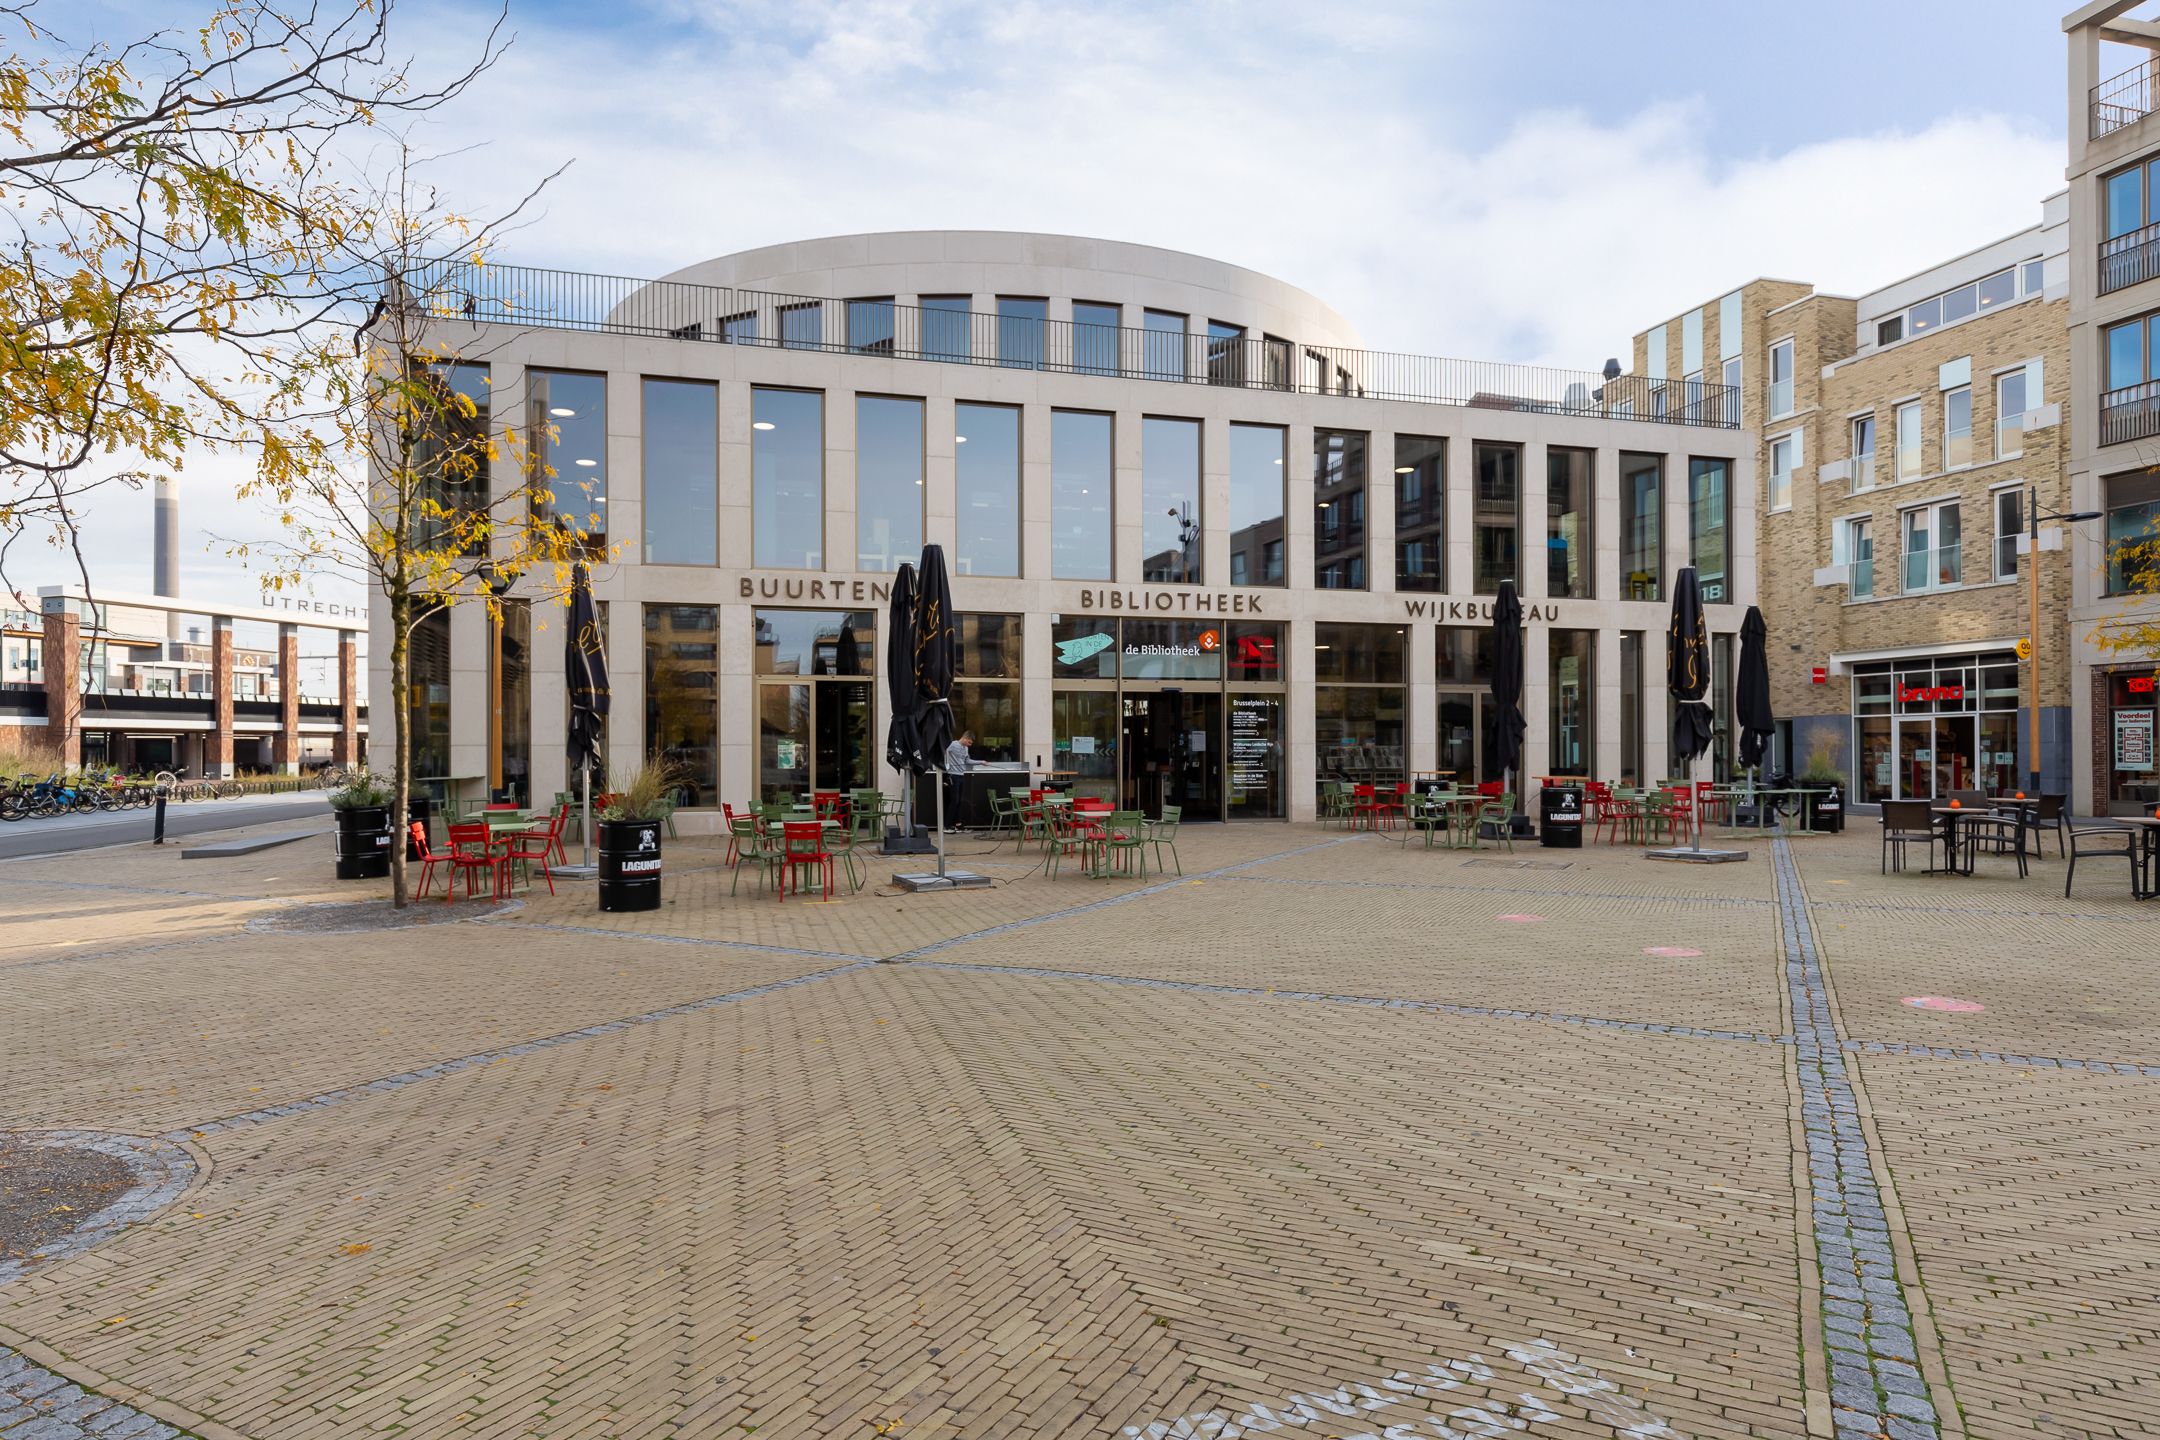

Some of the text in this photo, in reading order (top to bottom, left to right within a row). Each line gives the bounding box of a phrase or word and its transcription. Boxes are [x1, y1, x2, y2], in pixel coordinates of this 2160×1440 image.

[740, 577, 889, 601] BUURTEN
[262, 595, 369, 618] UTRECHT
[1081, 589, 1262, 613] BIBLIOTHEEK
[1405, 600, 1559, 623] WIJKBUAU
[1126, 644, 1200, 657] de Bibliotheek
[1898, 682, 1963, 702] bruna
